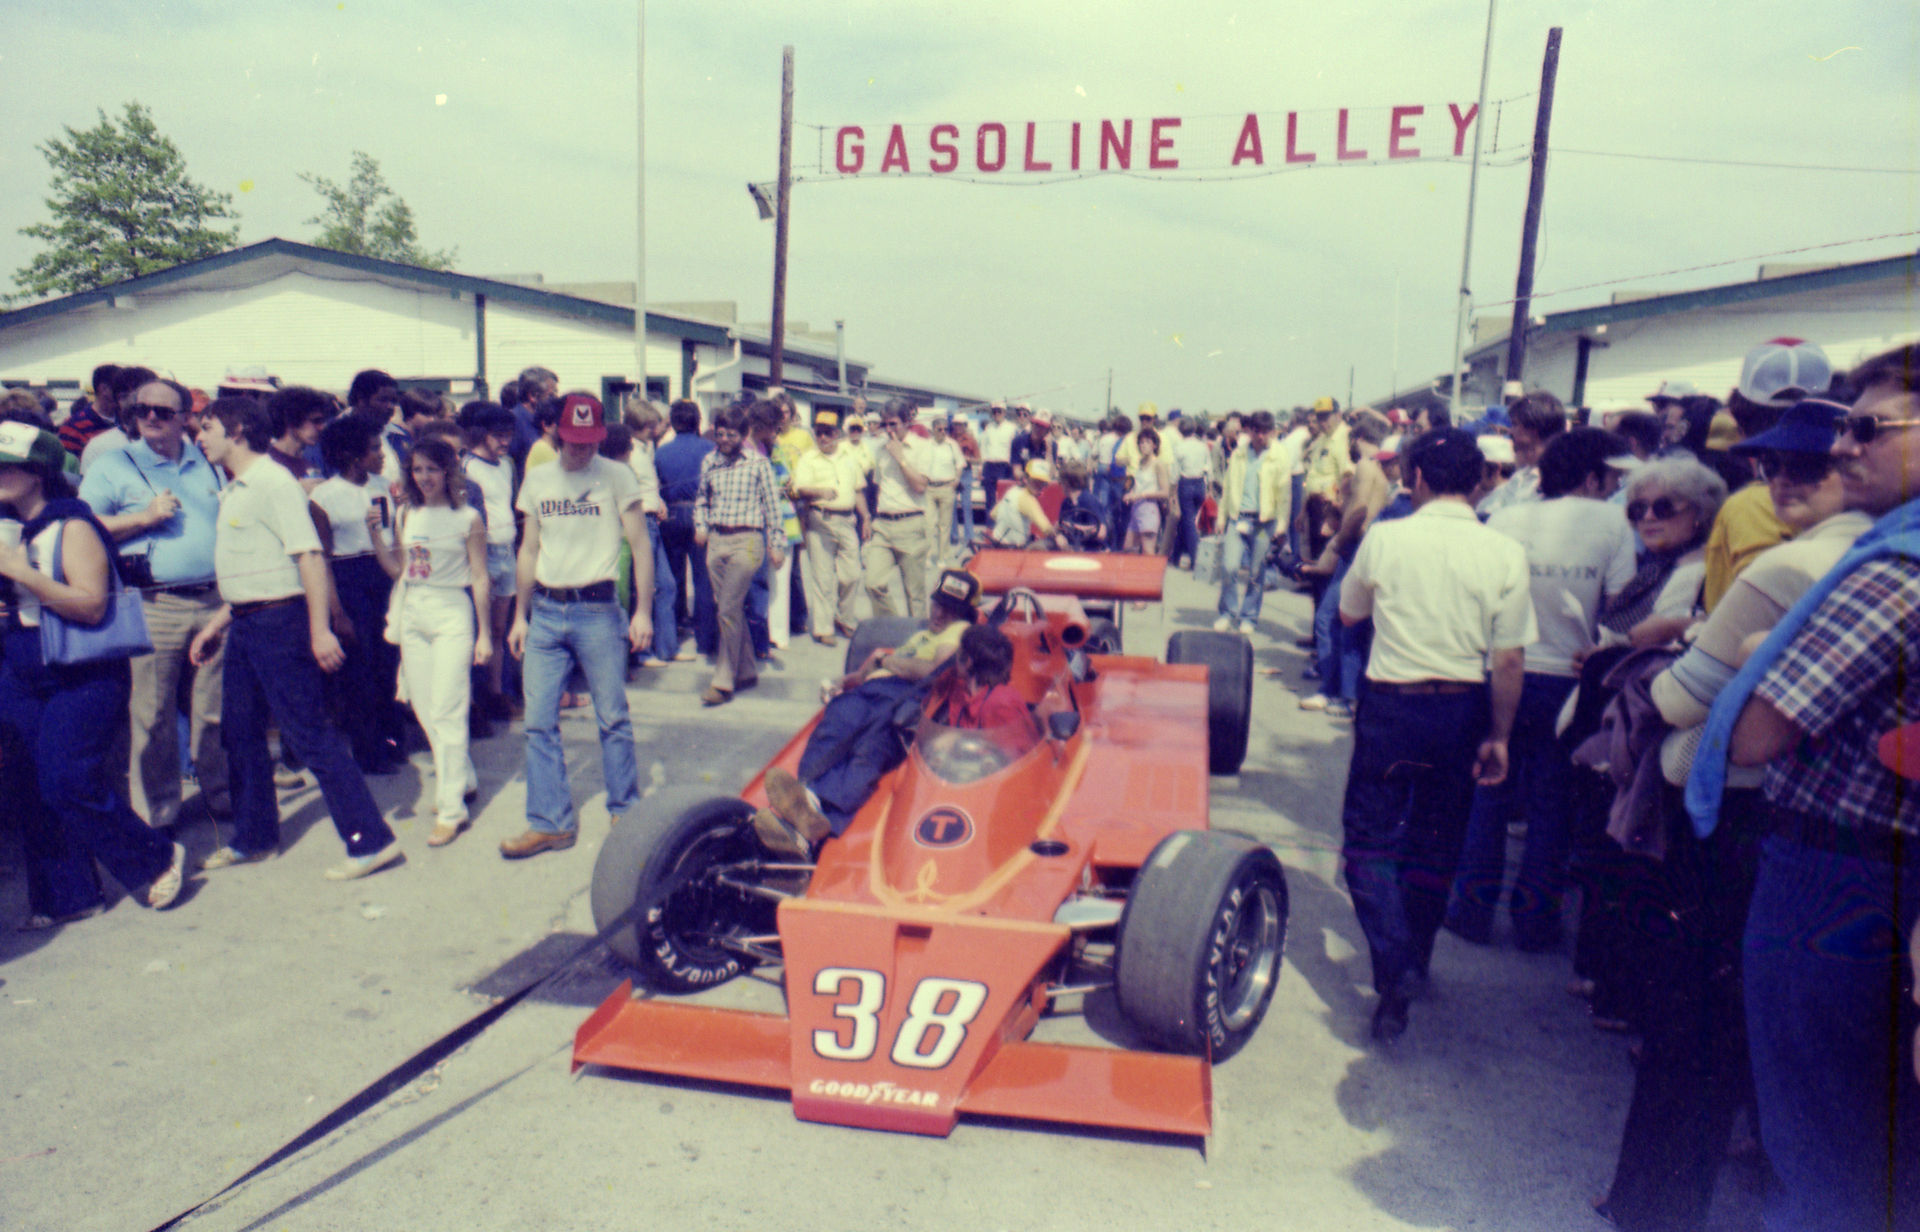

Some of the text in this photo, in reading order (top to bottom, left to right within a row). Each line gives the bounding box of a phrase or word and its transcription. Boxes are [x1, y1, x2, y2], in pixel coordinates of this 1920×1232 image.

[835, 102, 1479, 174] GASOLINE ALLEY
[541, 498, 601, 517] Wilson
[1529, 563, 1598, 579] KEVIN
[930, 815, 958, 841] T
[812, 966, 990, 1071] 38
[810, 1079, 940, 1108] GOODYEAR
